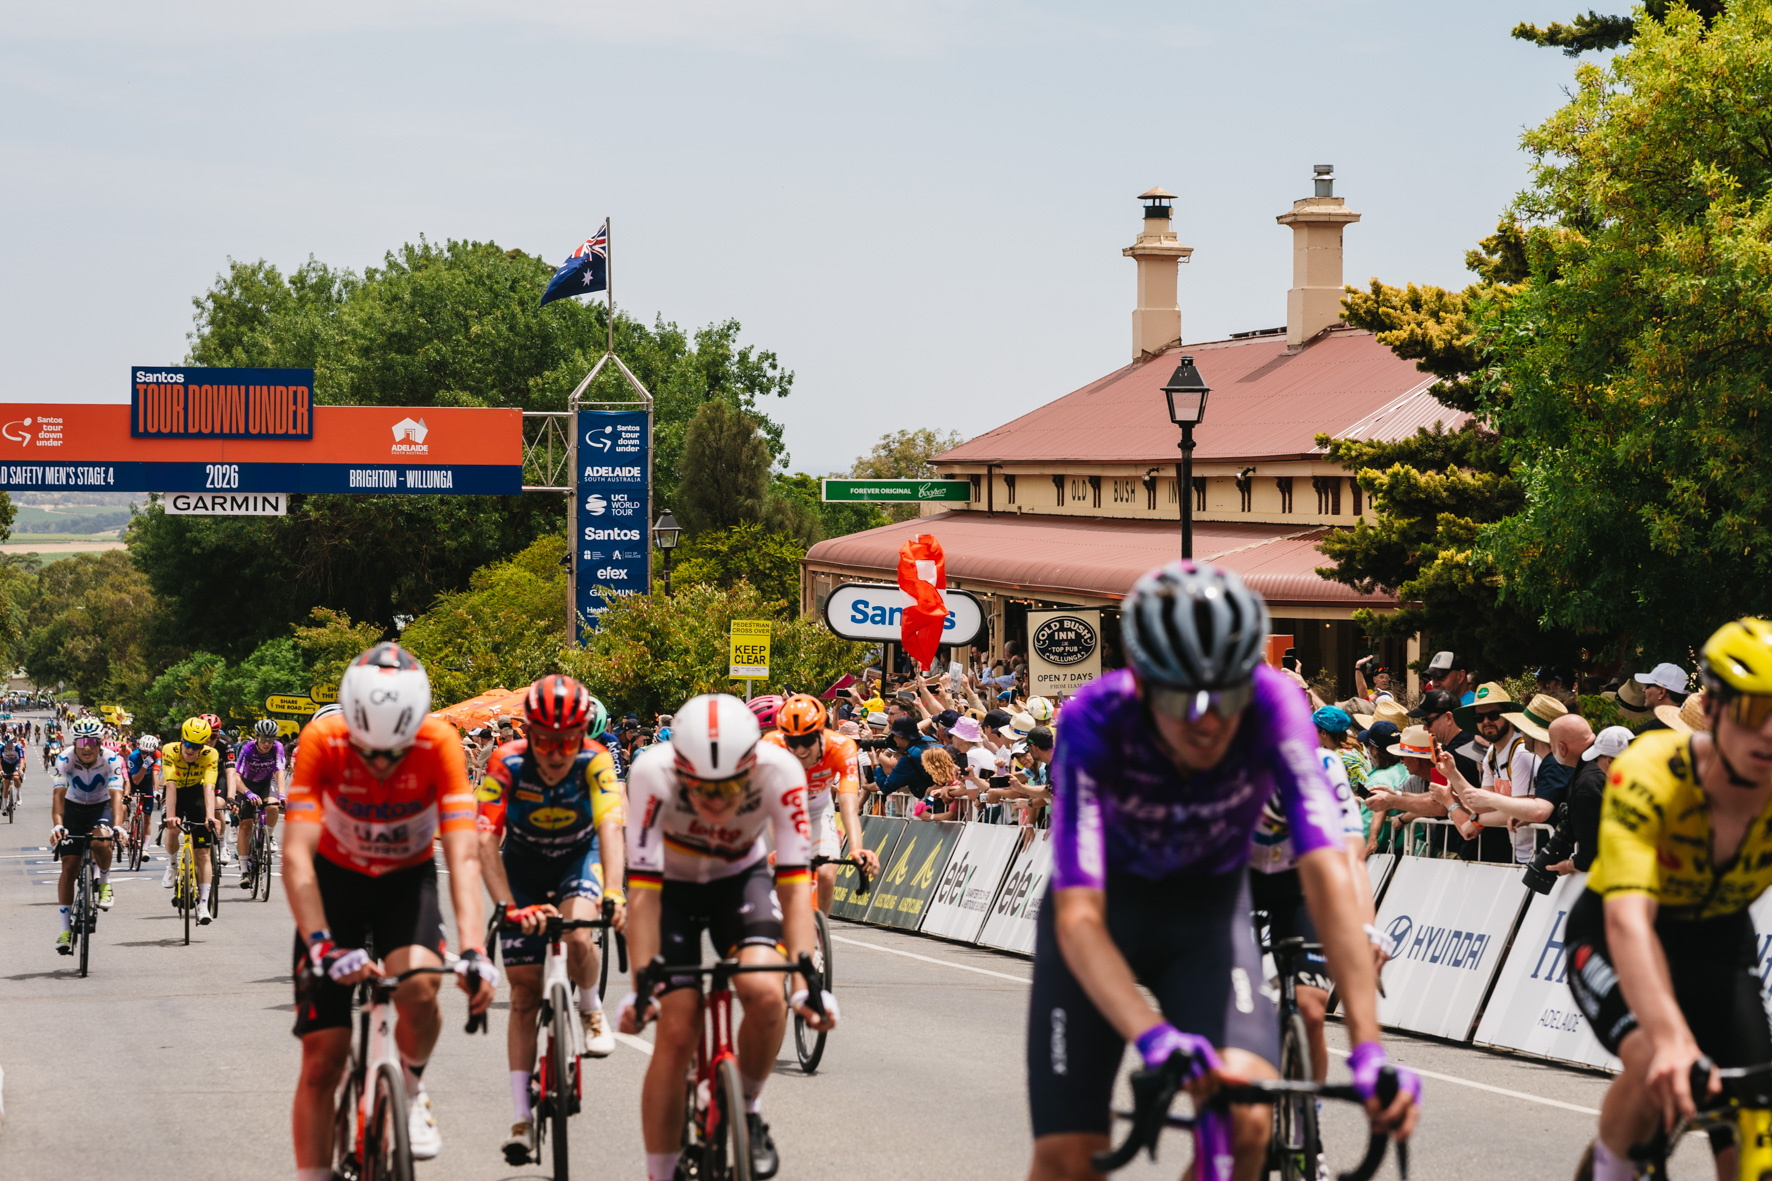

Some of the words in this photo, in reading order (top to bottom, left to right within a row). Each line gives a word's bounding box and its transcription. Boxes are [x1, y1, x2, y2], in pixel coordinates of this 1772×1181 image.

[136, 371, 184, 383] Santos
[136, 384, 184, 434] TOUR
[188, 384, 246, 434] DOWN
[249, 385, 308, 434] UNDER
[37, 416, 63, 424] Santos
[36, 439, 63, 447] under
[38, 431, 63, 439] down
[0, 467, 7, 484] D
[10, 467, 44, 484] SAFETY
[45, 467, 76, 485] MEN'S
[77, 468, 106, 485] STAGE
[107, 468, 114, 485] 4
[206, 464, 239, 488] 2026
[350, 470, 397, 488] BRIGHTON
[406, 470, 453, 489] WILLUNGA
[585, 467, 641, 476] ADELAIDE
[1072, 479, 1087, 501] OLD
[1114, 480, 1136, 503] BUSH
[1168, 481, 1177, 503] IN
[173, 495, 279, 512] GARMIN
[585, 527, 640, 540] Santos
[597, 566, 628, 579] efex
[851, 599, 956, 630] Sans
[1039, 621, 1060, 640] OLD
[1064, 620, 1092, 641] BUSH
[735, 645, 766, 654] KEEP
[1049, 653, 1082, 662] WILLUNGA
[734, 655, 766, 664] CLEAR
[1038, 674, 1060, 682] OPEN
[1070, 673, 1093, 681] DAYS
[606, 741, 622, 774] Adecco
[938, 851, 978, 907] efex
[998, 859, 1043, 918] efex
[1407, 925, 1491, 970] HYUNDAI
[1538, 1009, 1583, 1032] ADELAIDE
